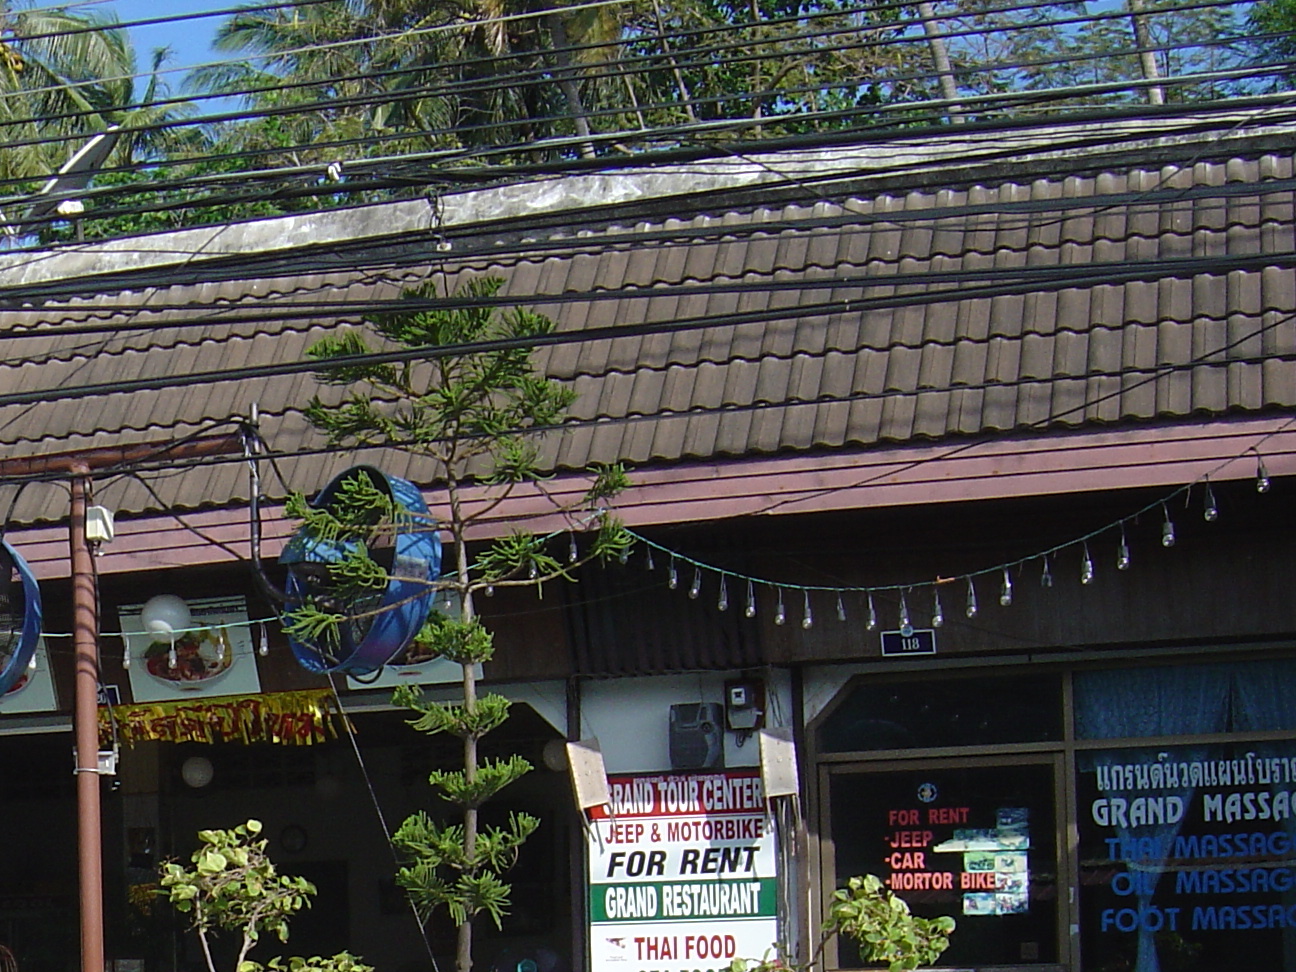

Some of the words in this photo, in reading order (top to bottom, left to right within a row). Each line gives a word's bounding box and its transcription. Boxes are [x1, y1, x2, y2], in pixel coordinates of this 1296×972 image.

[902, 638, 920, 650] 118
[658, 781, 699, 813] TOUR
[703, 777, 763, 810] CENTER
[889, 810, 919, 826] FOR
[929, 808, 969, 824] RENT
[1092, 795, 1184, 829] GRAND
[1204, 791, 1296, 824] MASSA
[605, 823, 644, 844] JEEP
[651, 823, 661, 842] &
[668, 819, 763, 842] MOTORBIKE
[1105, 837, 1161, 861] THAI
[1174, 831, 1296, 859] MASSAG
[607, 850, 667, 878] FOR
[679, 846, 760, 875] RENT
[1111, 872, 1154, 896] OIL
[1175, 868, 1296, 894] MASSAG
[605, 884, 657, 919] GRAND
[663, 882, 761, 917] RESTAURANT
[1101, 907, 1180, 932] FOOT
[634, 936, 677, 960] THAI
[685, 935, 736, 960] FOOD
